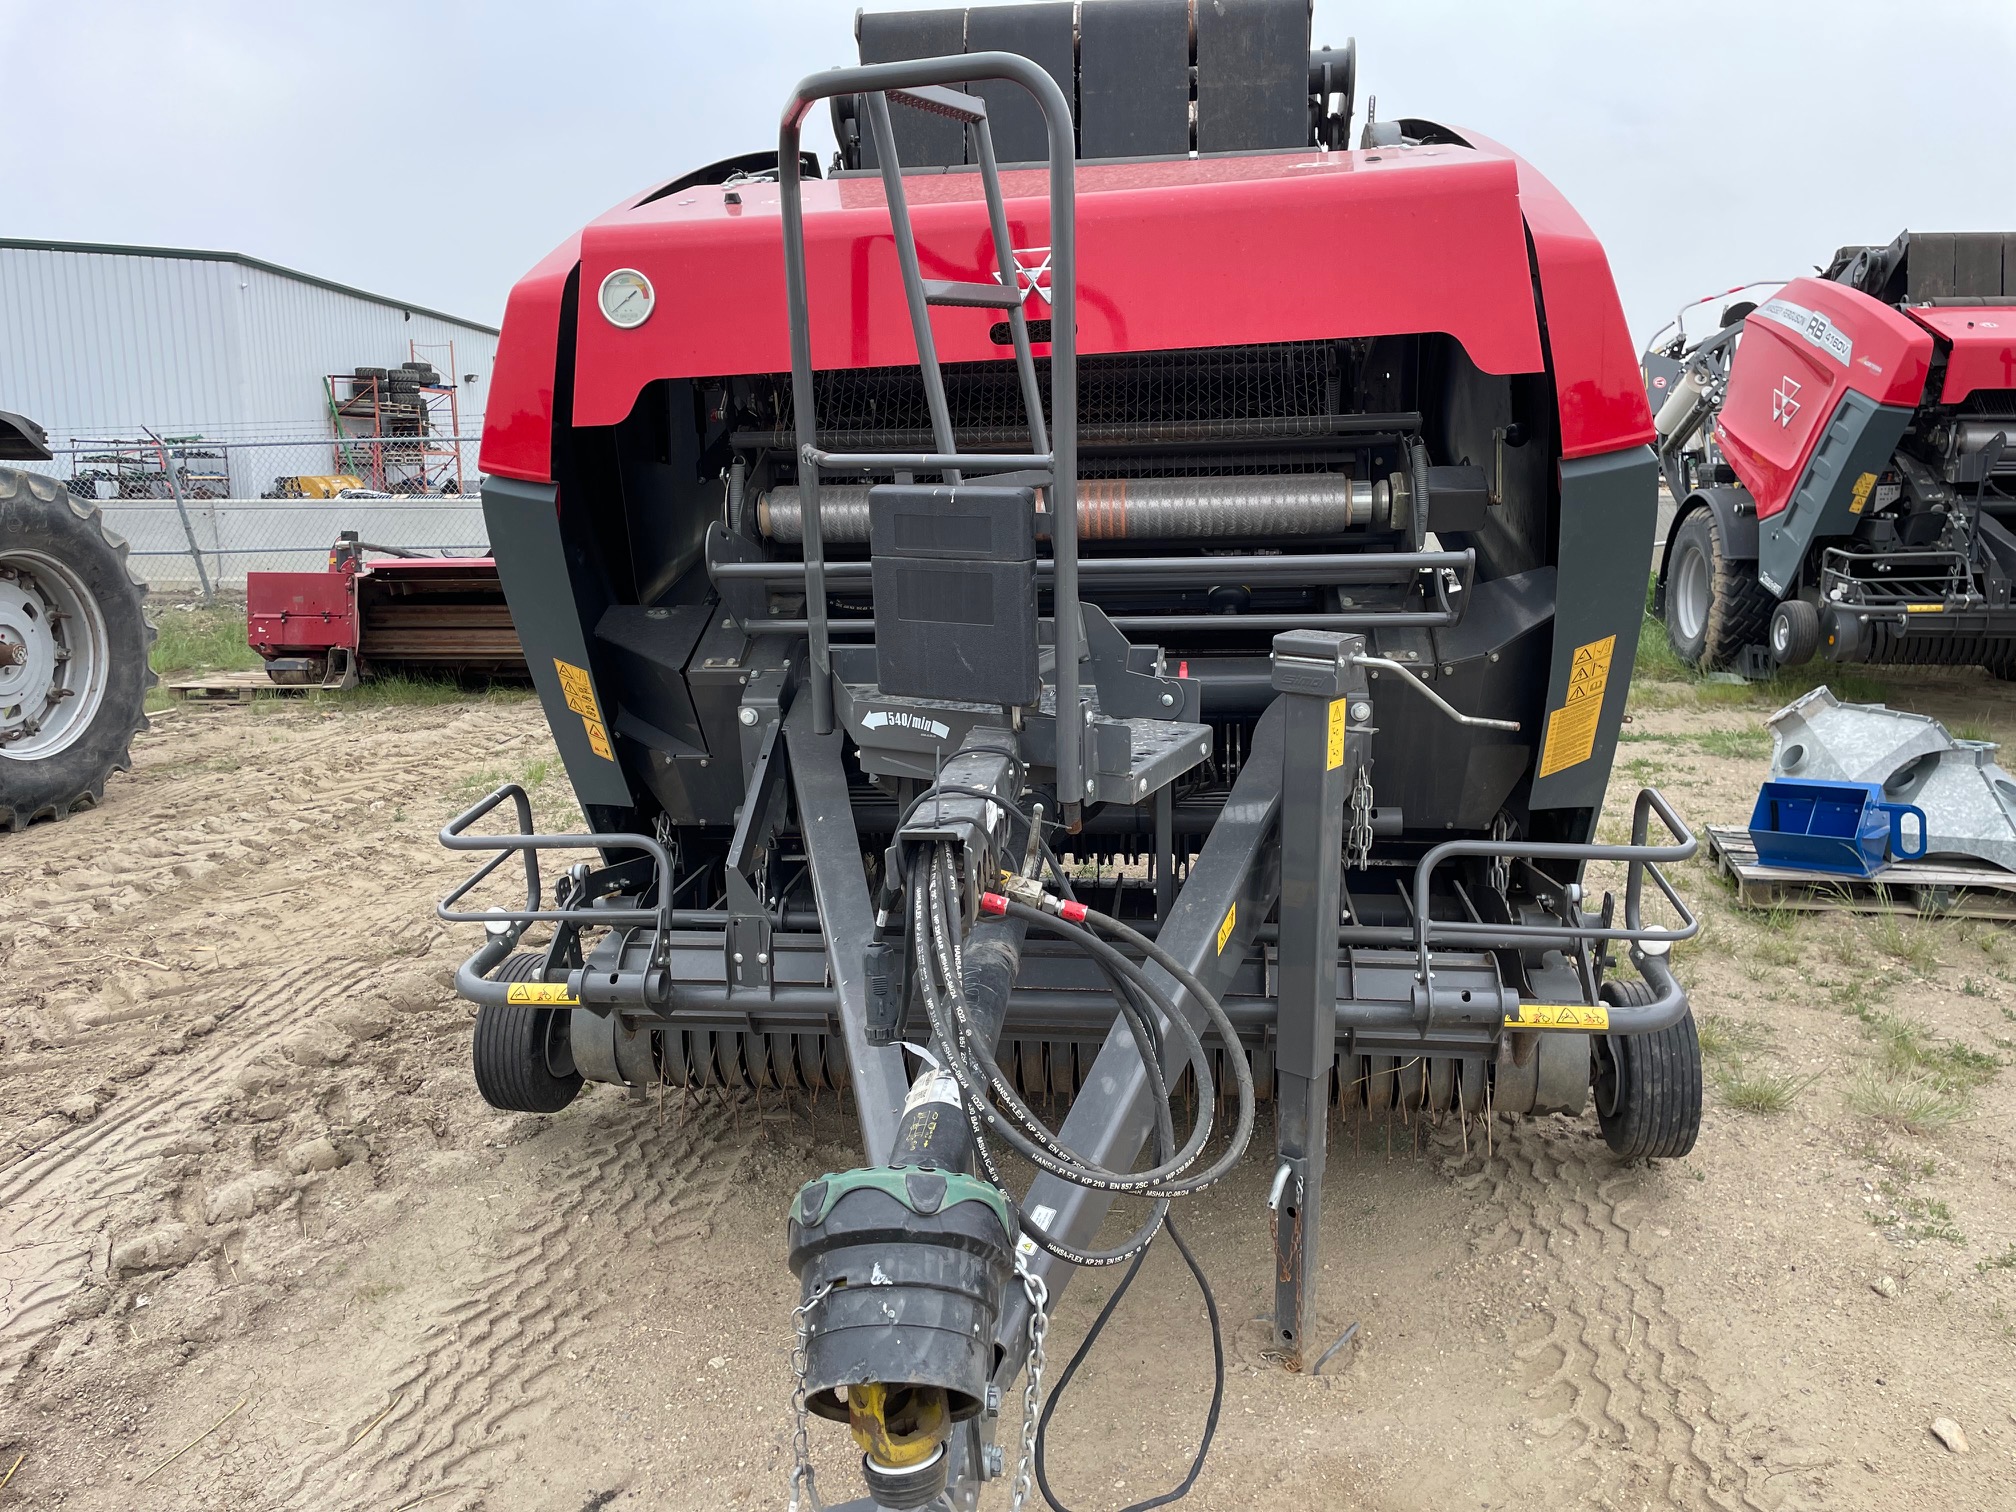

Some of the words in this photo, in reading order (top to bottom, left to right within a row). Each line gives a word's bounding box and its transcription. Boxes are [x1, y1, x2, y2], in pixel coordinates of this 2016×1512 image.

[1805, 316, 1827, 340] RB
[1826, 333, 1849, 354] 4160V
[887, 711, 932, 732] 540/min
[955, 1005, 968, 1024] 1Q22
[941, 1041, 955, 1062] MSHA
[970, 1093, 986, 1112] 1Q22
[970, 1115, 980, 1133] BAR
[976, 1136, 989, 1161] MSHA
[991, 1077, 1026, 1122] HANSA-FLEX
[1025, 1121, 1037, 1133] KP
[1034, 1130, 1047, 1144] 210
[1047, 1142, 1060, 1155] EN
[1057, 1150, 1071, 1162] 857
[1031, 1152, 1078, 1181] HANSA-FLEX
[1080, 1176, 1093, 1185] KP
[1092, 1180, 1106, 1189] 210
[1109, 1182, 1120, 1190] EN
[1120, 1182, 1134, 1190] 857
[1135, 1180, 1149, 1190] 2SC
[1152, 1178, 1160, 1186] 10
[1047, 1242, 1084, 1264] HANSA-FLEX
